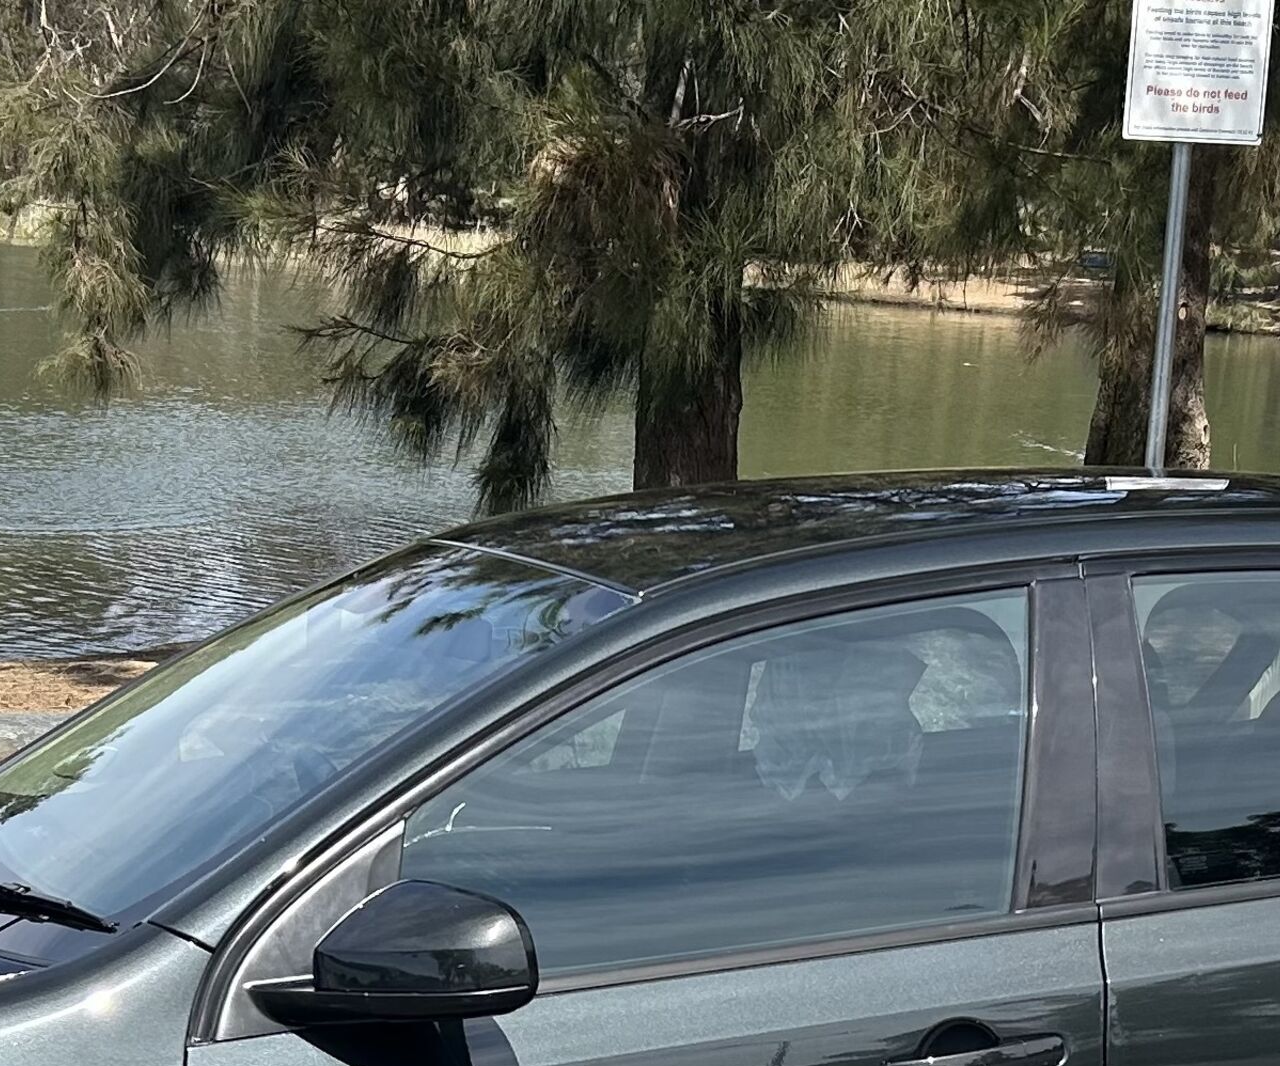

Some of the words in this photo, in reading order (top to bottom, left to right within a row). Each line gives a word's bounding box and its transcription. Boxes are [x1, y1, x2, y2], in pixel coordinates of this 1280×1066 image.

[1146, 85, 1182, 97] Please
[1186, 87, 1200, 97] do
[1203, 89, 1221, 99] not
[1224, 89, 1248, 100] feed
[1171, 102, 1189, 113] the
[1192, 102, 1220, 114] birds
